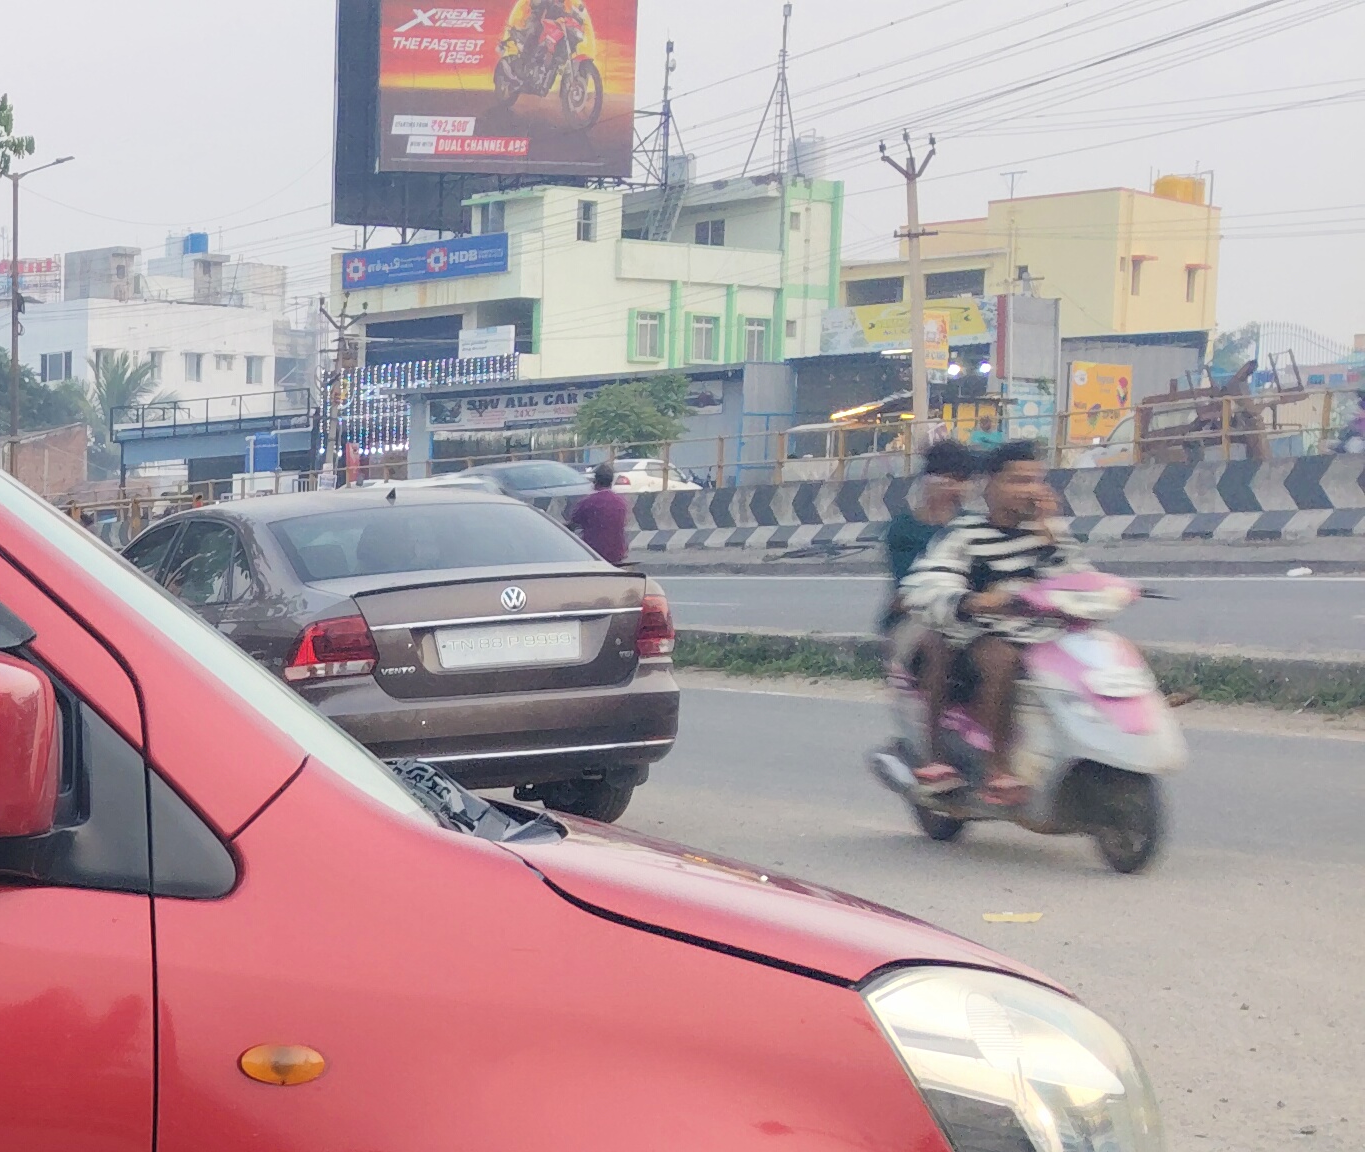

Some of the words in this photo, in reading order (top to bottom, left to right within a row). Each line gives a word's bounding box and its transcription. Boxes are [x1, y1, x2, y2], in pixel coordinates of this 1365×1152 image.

[392, 37, 421, 50] THE
[421, 38, 485, 51] FASTEST
[437, 138, 463, 152] DUAL
[464, 139, 506, 152] CHANNEL
[507, 140, 527, 153] ABS
[449, 249, 477, 264] HDB
[504, 396, 538, 409] ALL
[543, 393, 578, 406] CAR
[447, 639, 474, 651] TN
[507, 635, 519, 648] P
[523, 632, 572, 648] 9999
[380, 665, 416, 676] VENTO
